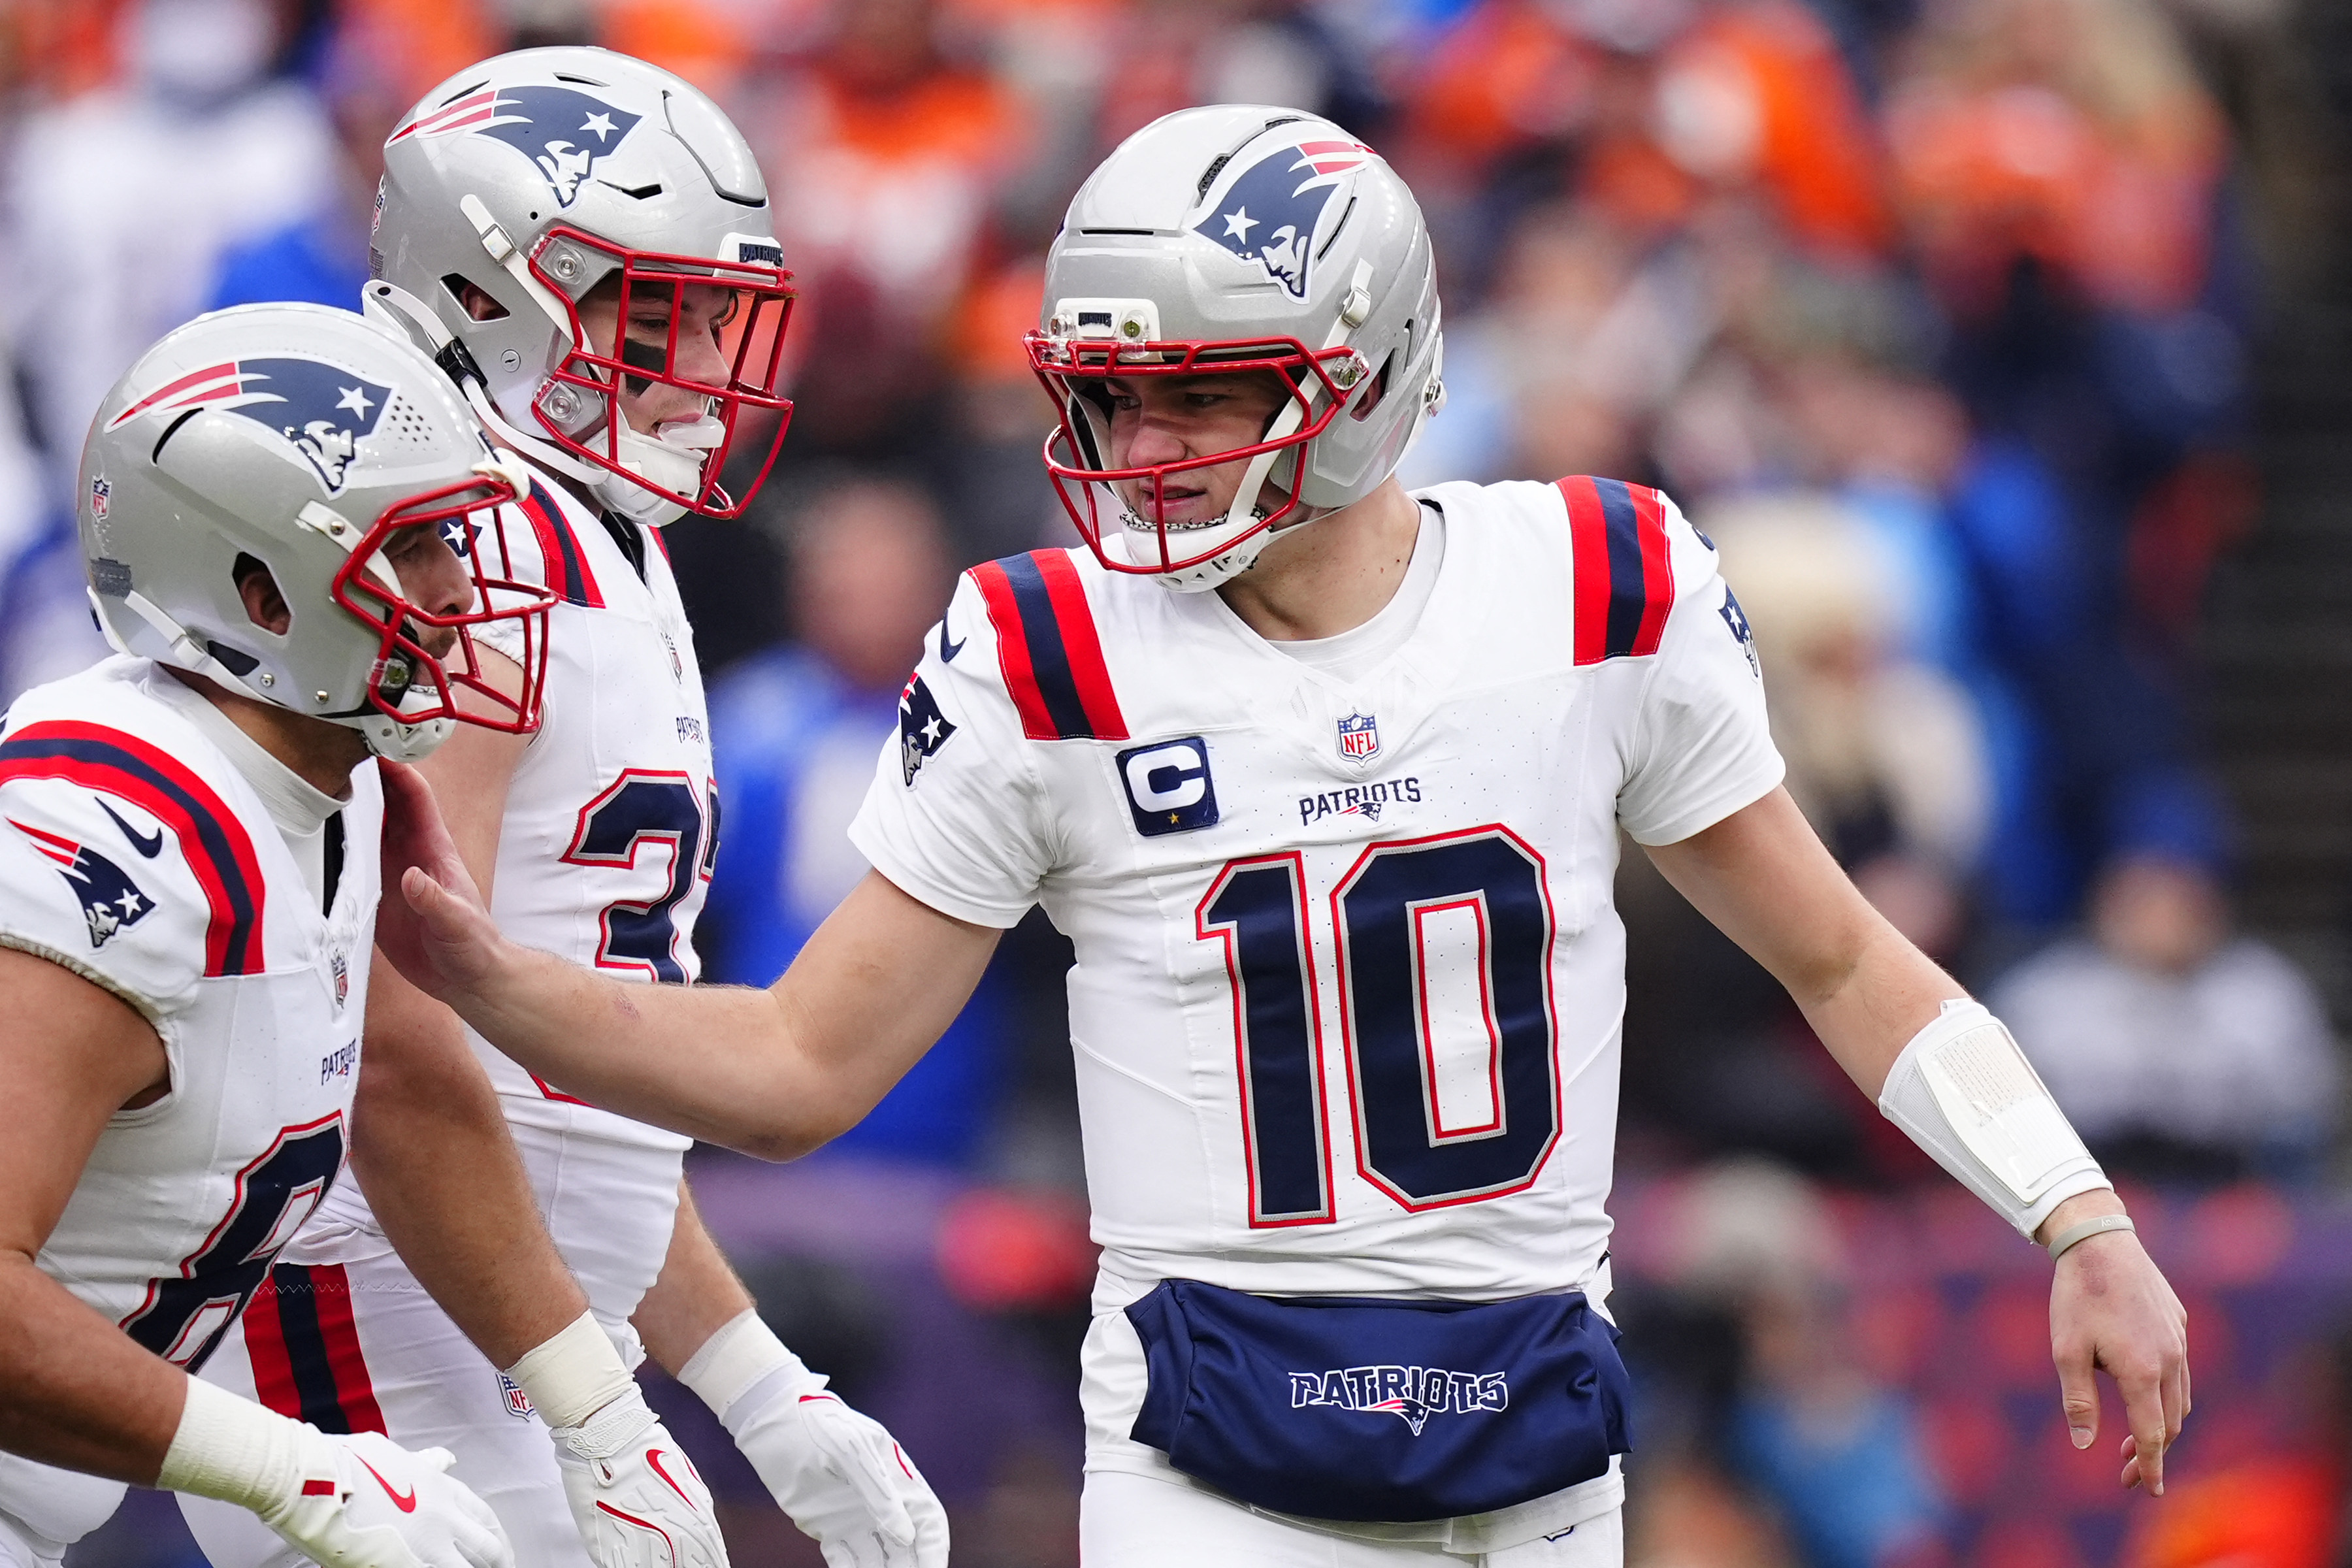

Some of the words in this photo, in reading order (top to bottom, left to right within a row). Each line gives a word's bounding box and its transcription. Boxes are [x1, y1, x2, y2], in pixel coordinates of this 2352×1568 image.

[1343, 732, 1375, 755] NFL
[1126, 745, 1205, 813] C
[1299, 777, 1421, 826] PATRIOTS
[1195, 822, 1563, 1229] 10
[509, 1390, 534, 1411] NF
[1288, 1365, 1509, 1414] PATRIOTS
